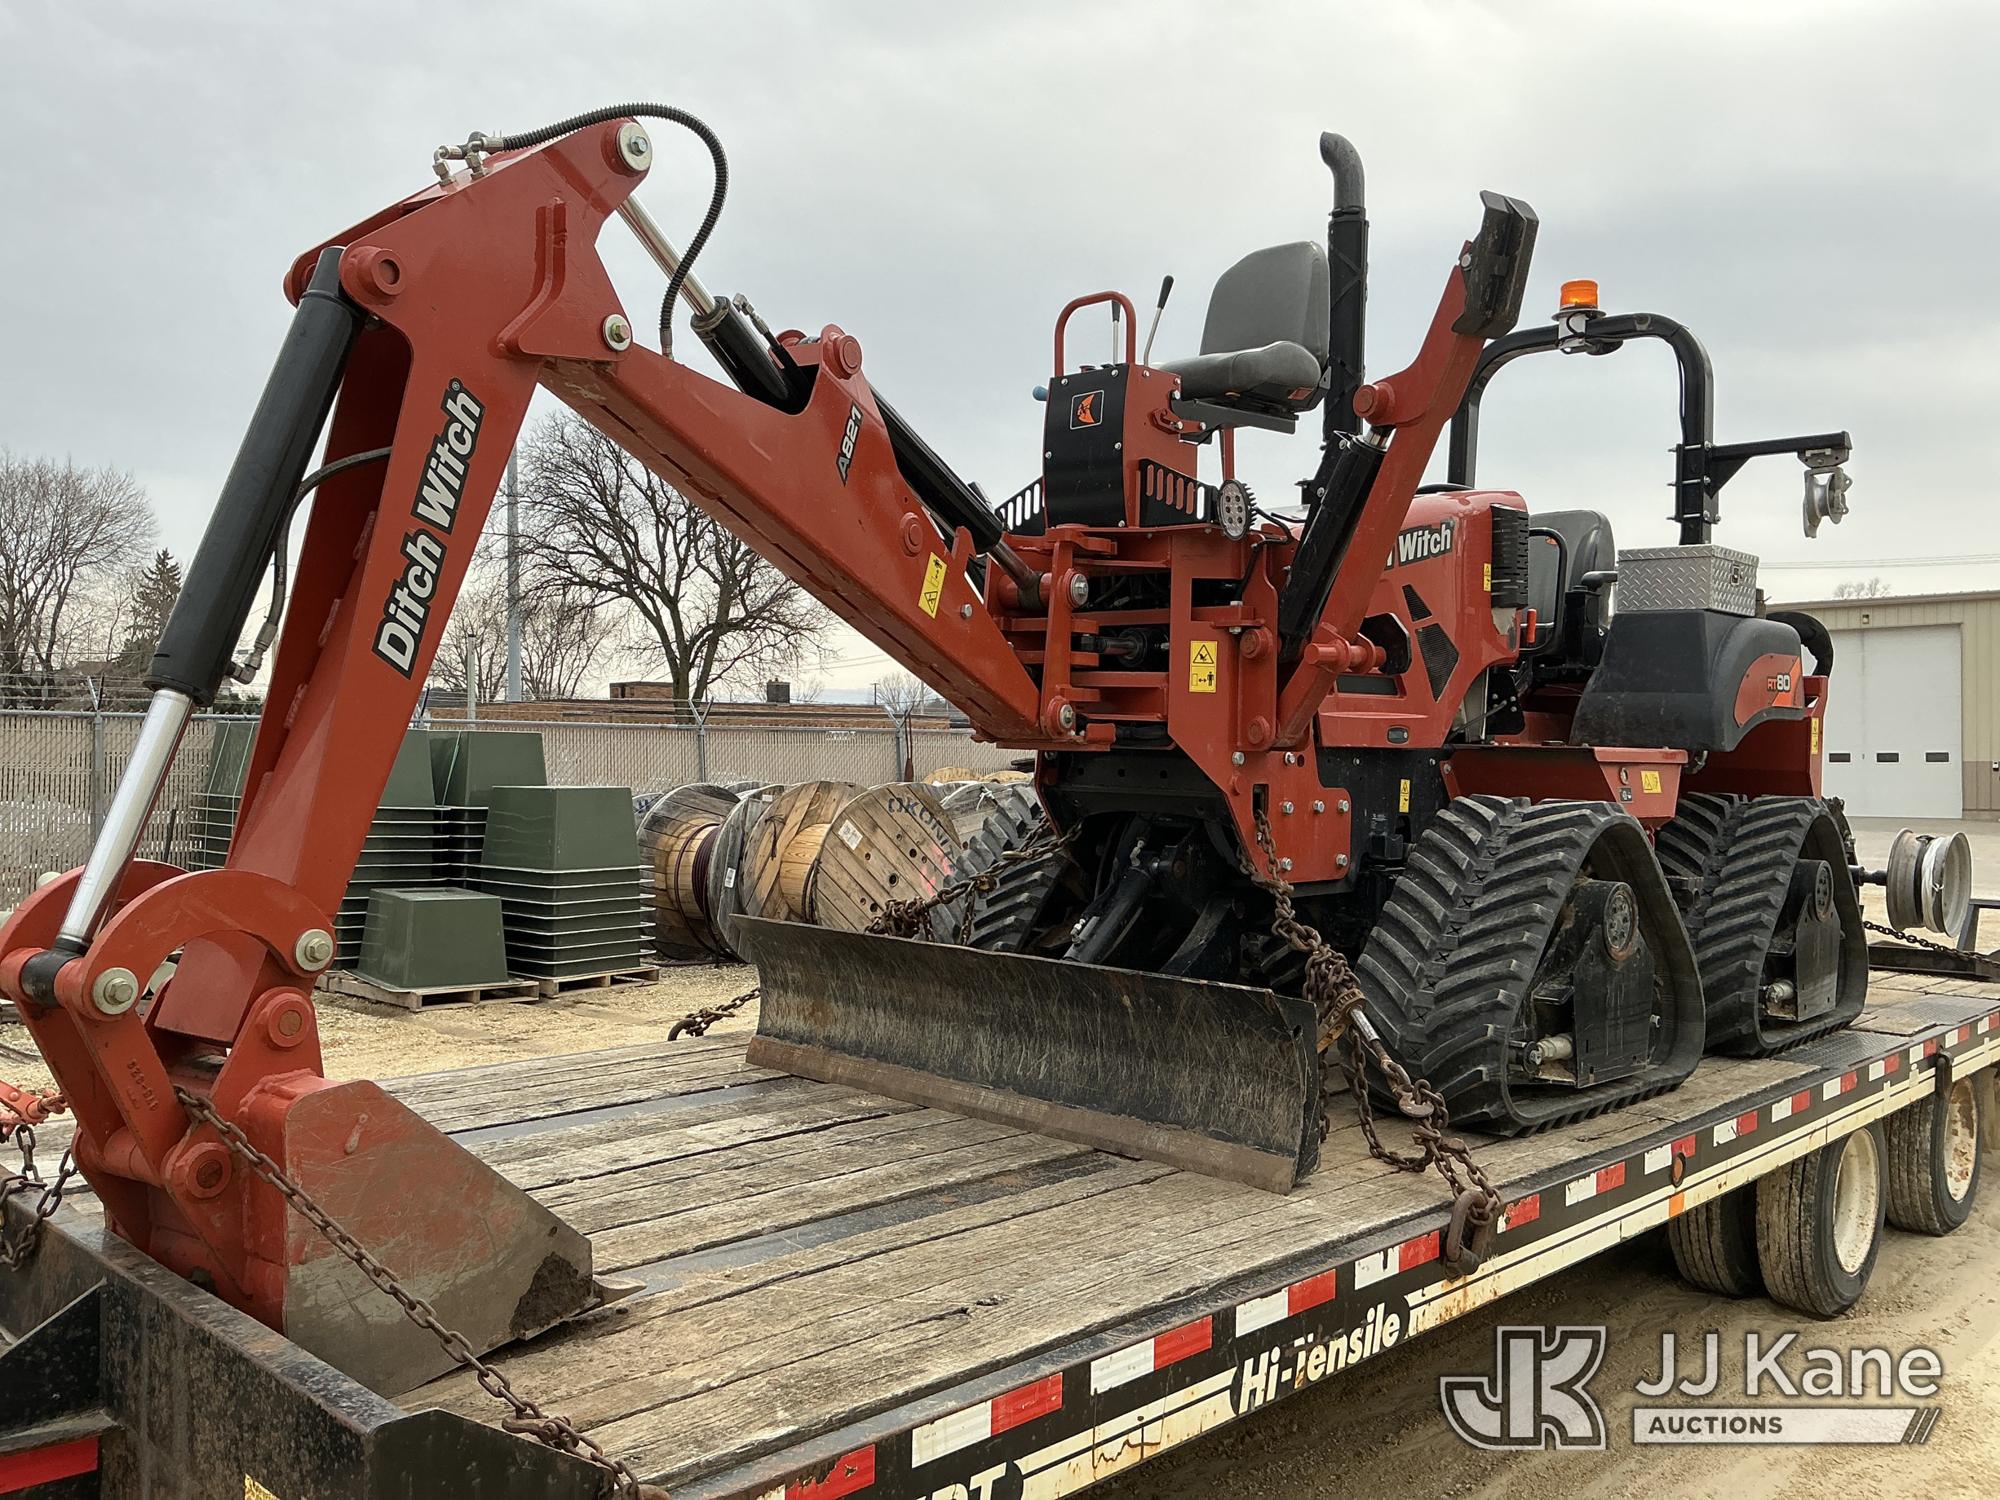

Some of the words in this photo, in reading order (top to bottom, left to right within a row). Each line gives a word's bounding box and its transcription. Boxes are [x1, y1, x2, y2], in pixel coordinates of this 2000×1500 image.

[838, 405, 862, 480] A821
[377, 532, 442, 671] Ditch
[416, 392, 482, 529] Witch
[1398, 523, 1451, 562] Witch
